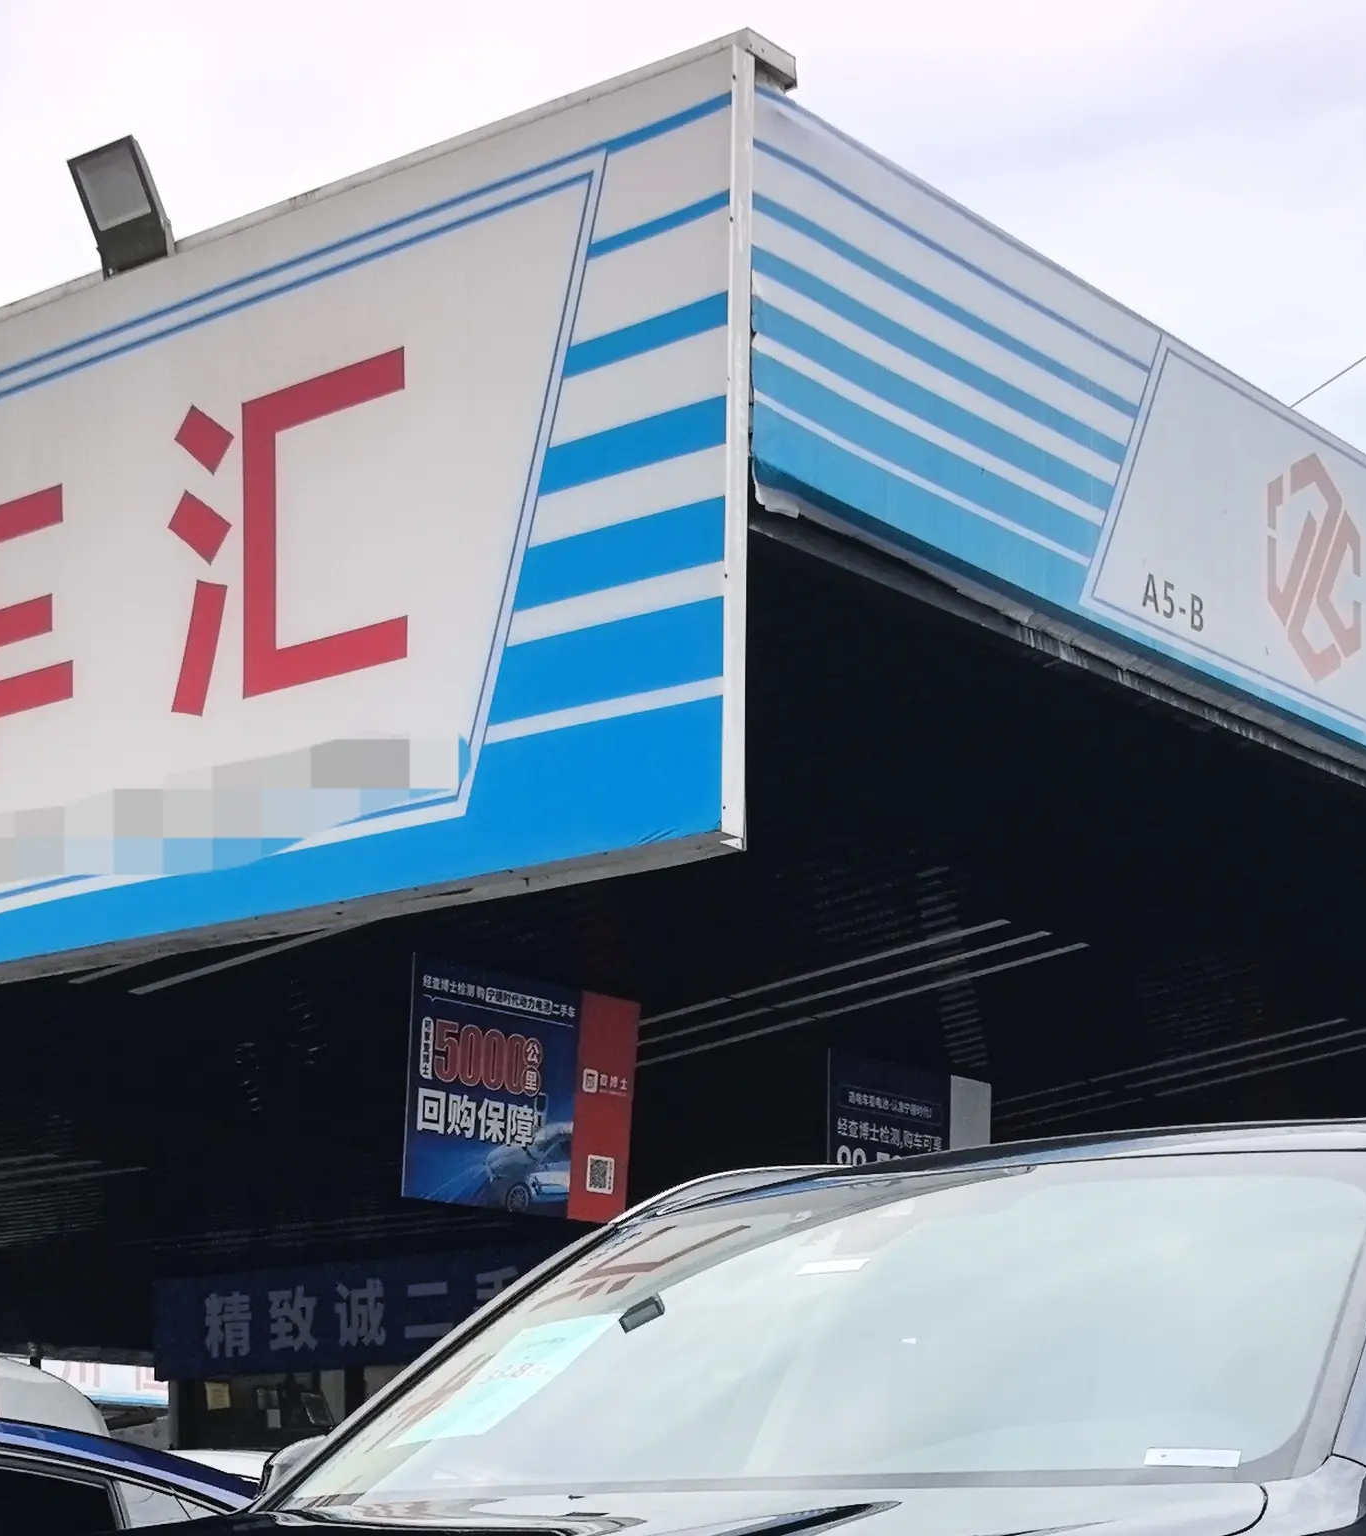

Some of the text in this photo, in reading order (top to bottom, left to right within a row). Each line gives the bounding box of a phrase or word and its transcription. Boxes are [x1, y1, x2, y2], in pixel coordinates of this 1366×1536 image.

[1141, 571, 1206, 633] A5-B
[434, 1018, 527, 1095] 5000
[416, 1088, 538, 1148] 回购保障
